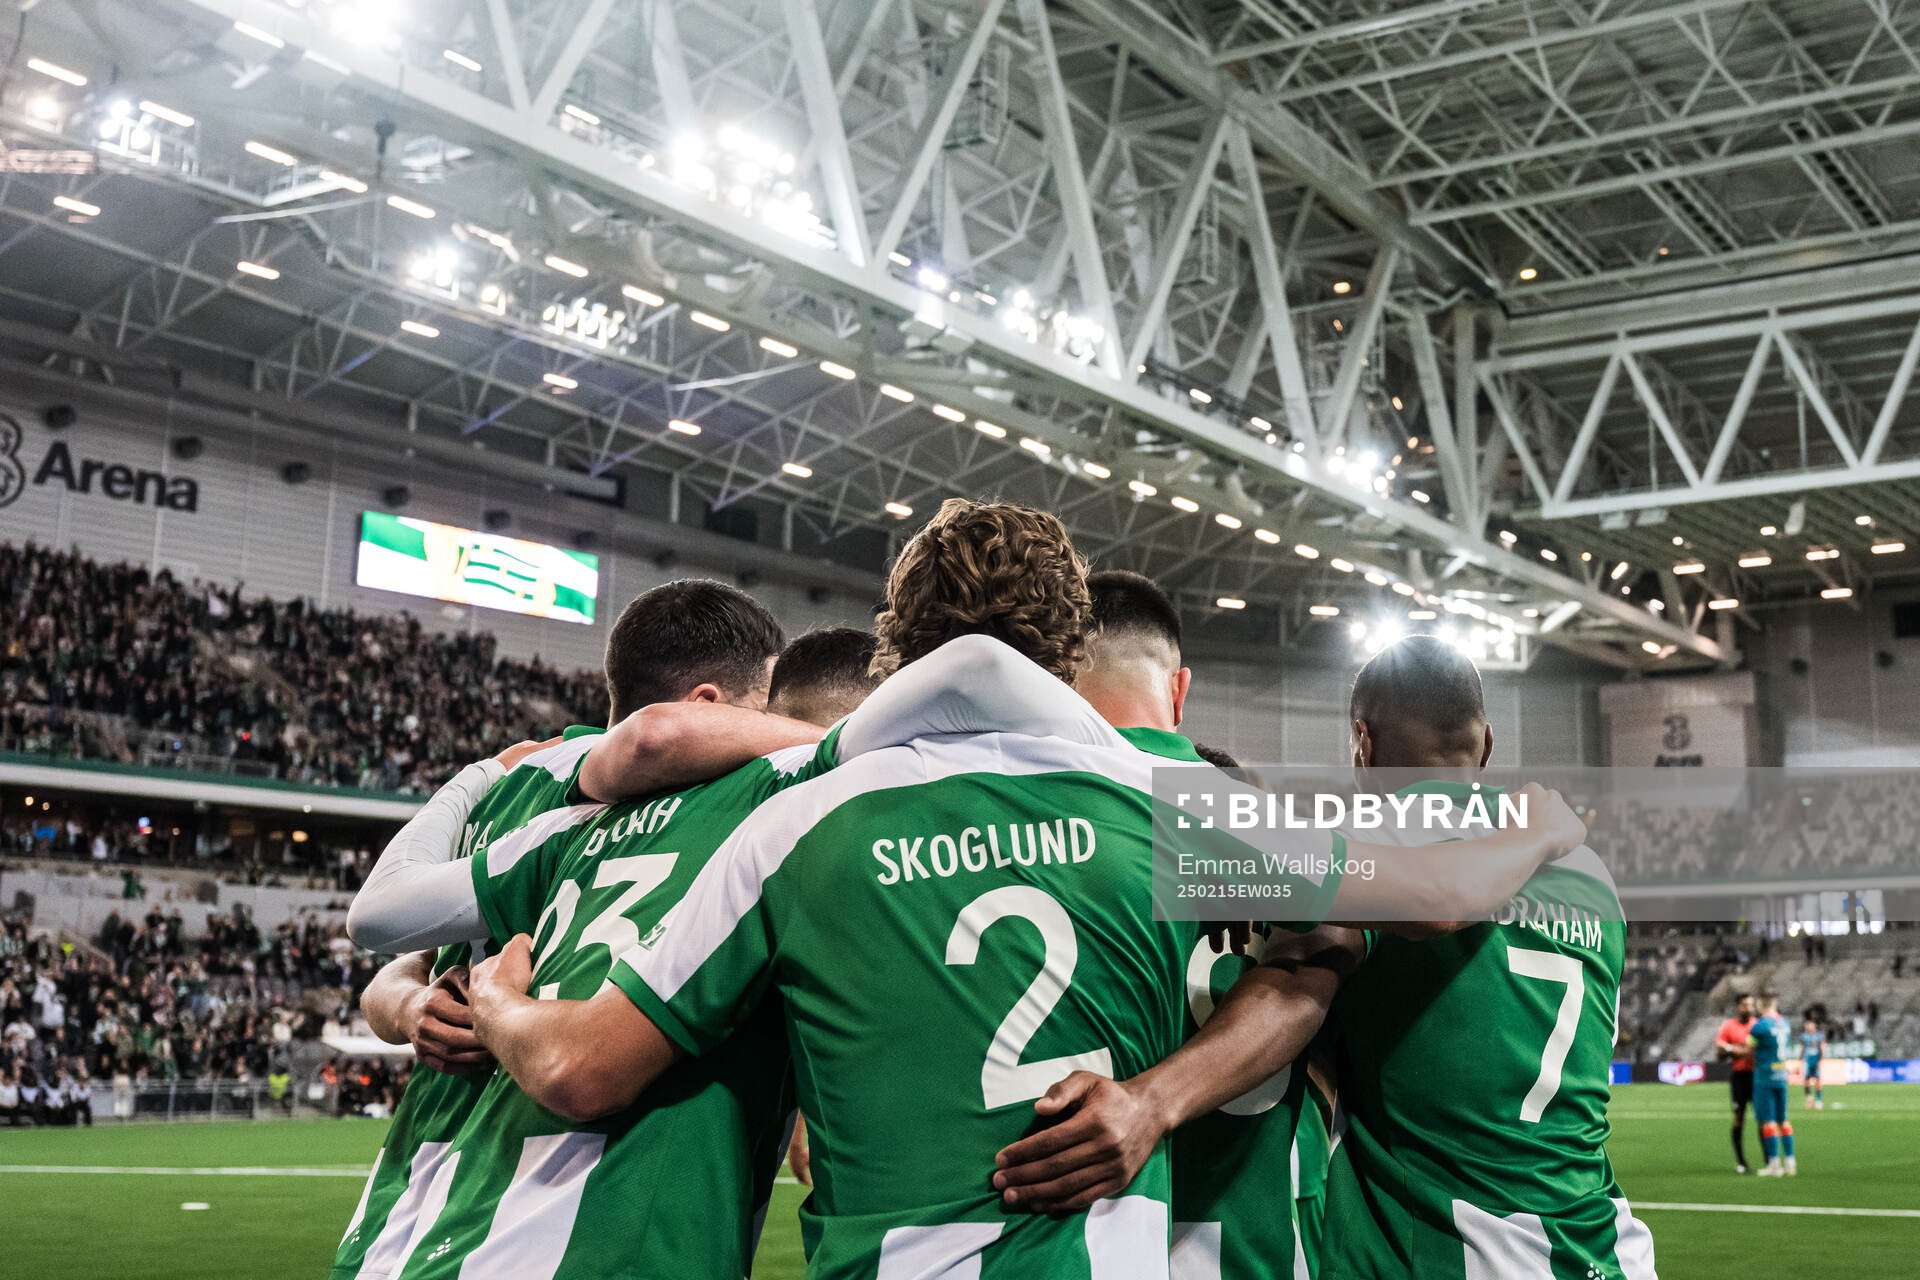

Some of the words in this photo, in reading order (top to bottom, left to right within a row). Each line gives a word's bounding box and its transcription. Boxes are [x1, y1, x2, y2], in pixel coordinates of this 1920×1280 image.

[33, 440, 199, 514] Arena
[872, 817, 1096, 885] SKOGLUND
[944, 885, 1114, 1110] 2
[1506, 945, 1585, 1124] 7
